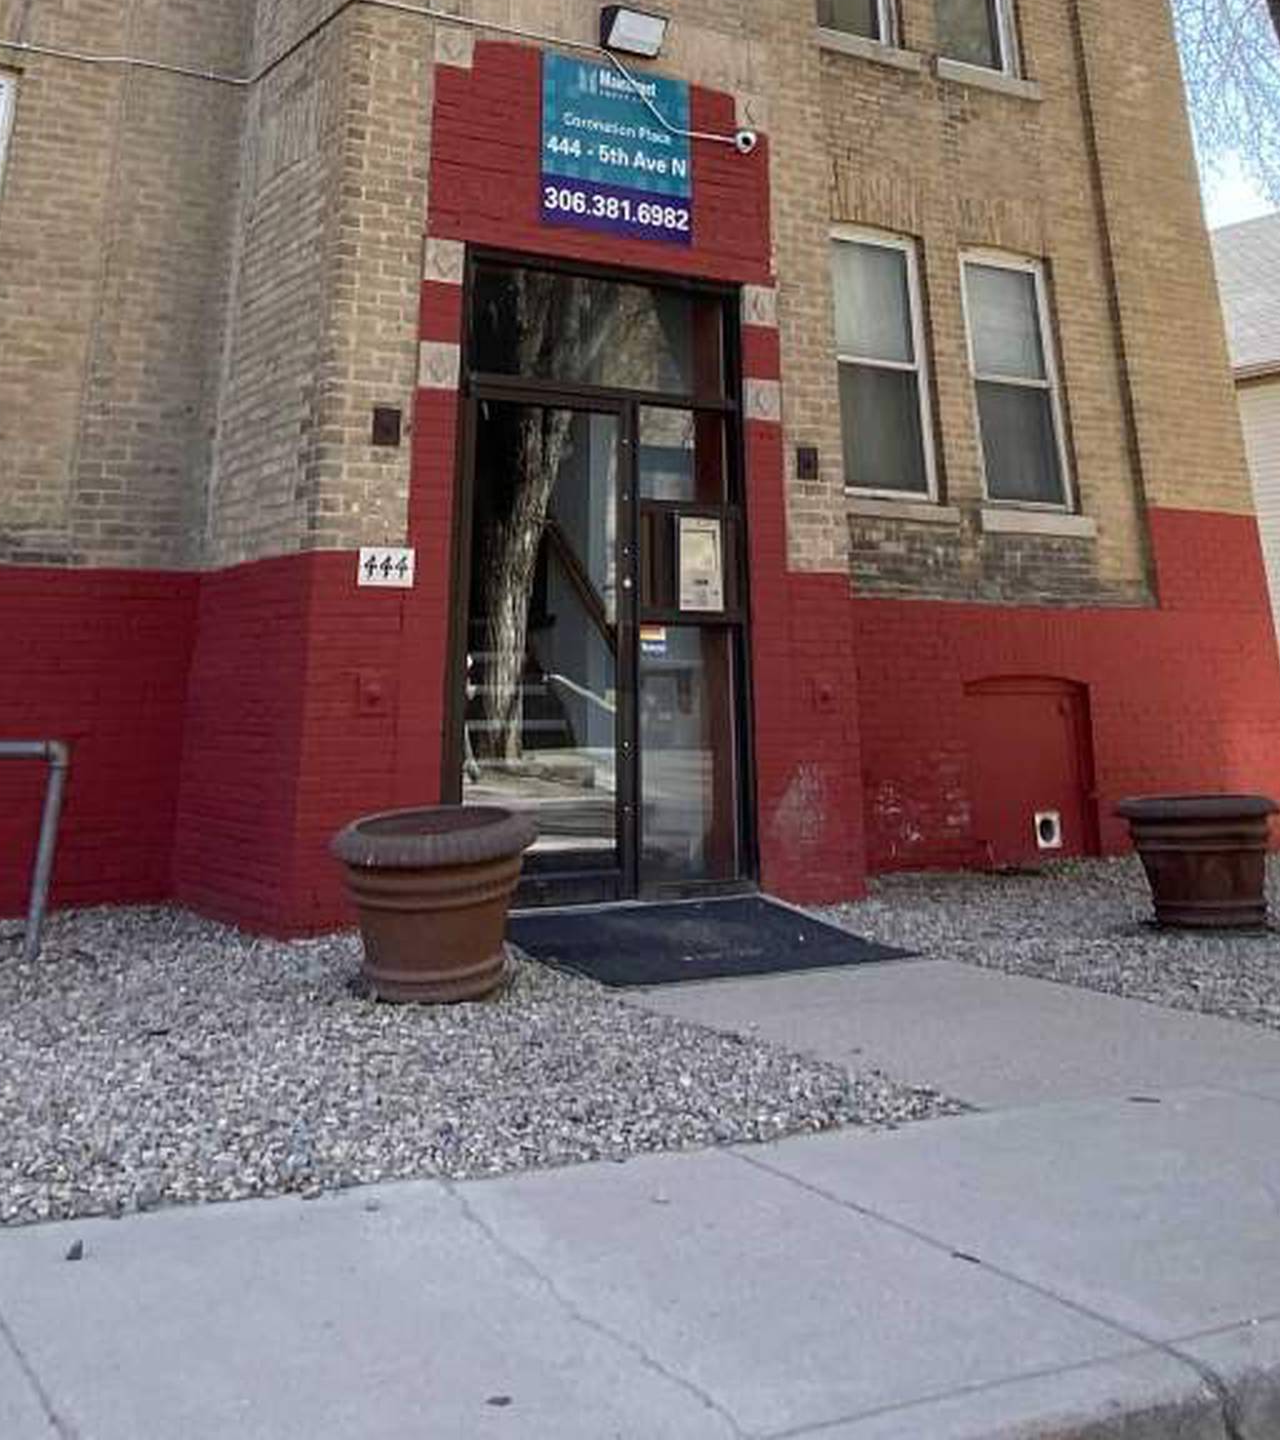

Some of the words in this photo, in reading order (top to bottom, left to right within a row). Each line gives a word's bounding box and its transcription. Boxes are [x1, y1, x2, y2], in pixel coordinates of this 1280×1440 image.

[547, 135, 581, 158] 444
[599, 144, 629, 166] 5th
[632, 151, 667, 174] Ave
[671, 158, 686, 178] N
[544, 186, 689, 231] 306.381.6982
[364, 555, 408, 578] 444
